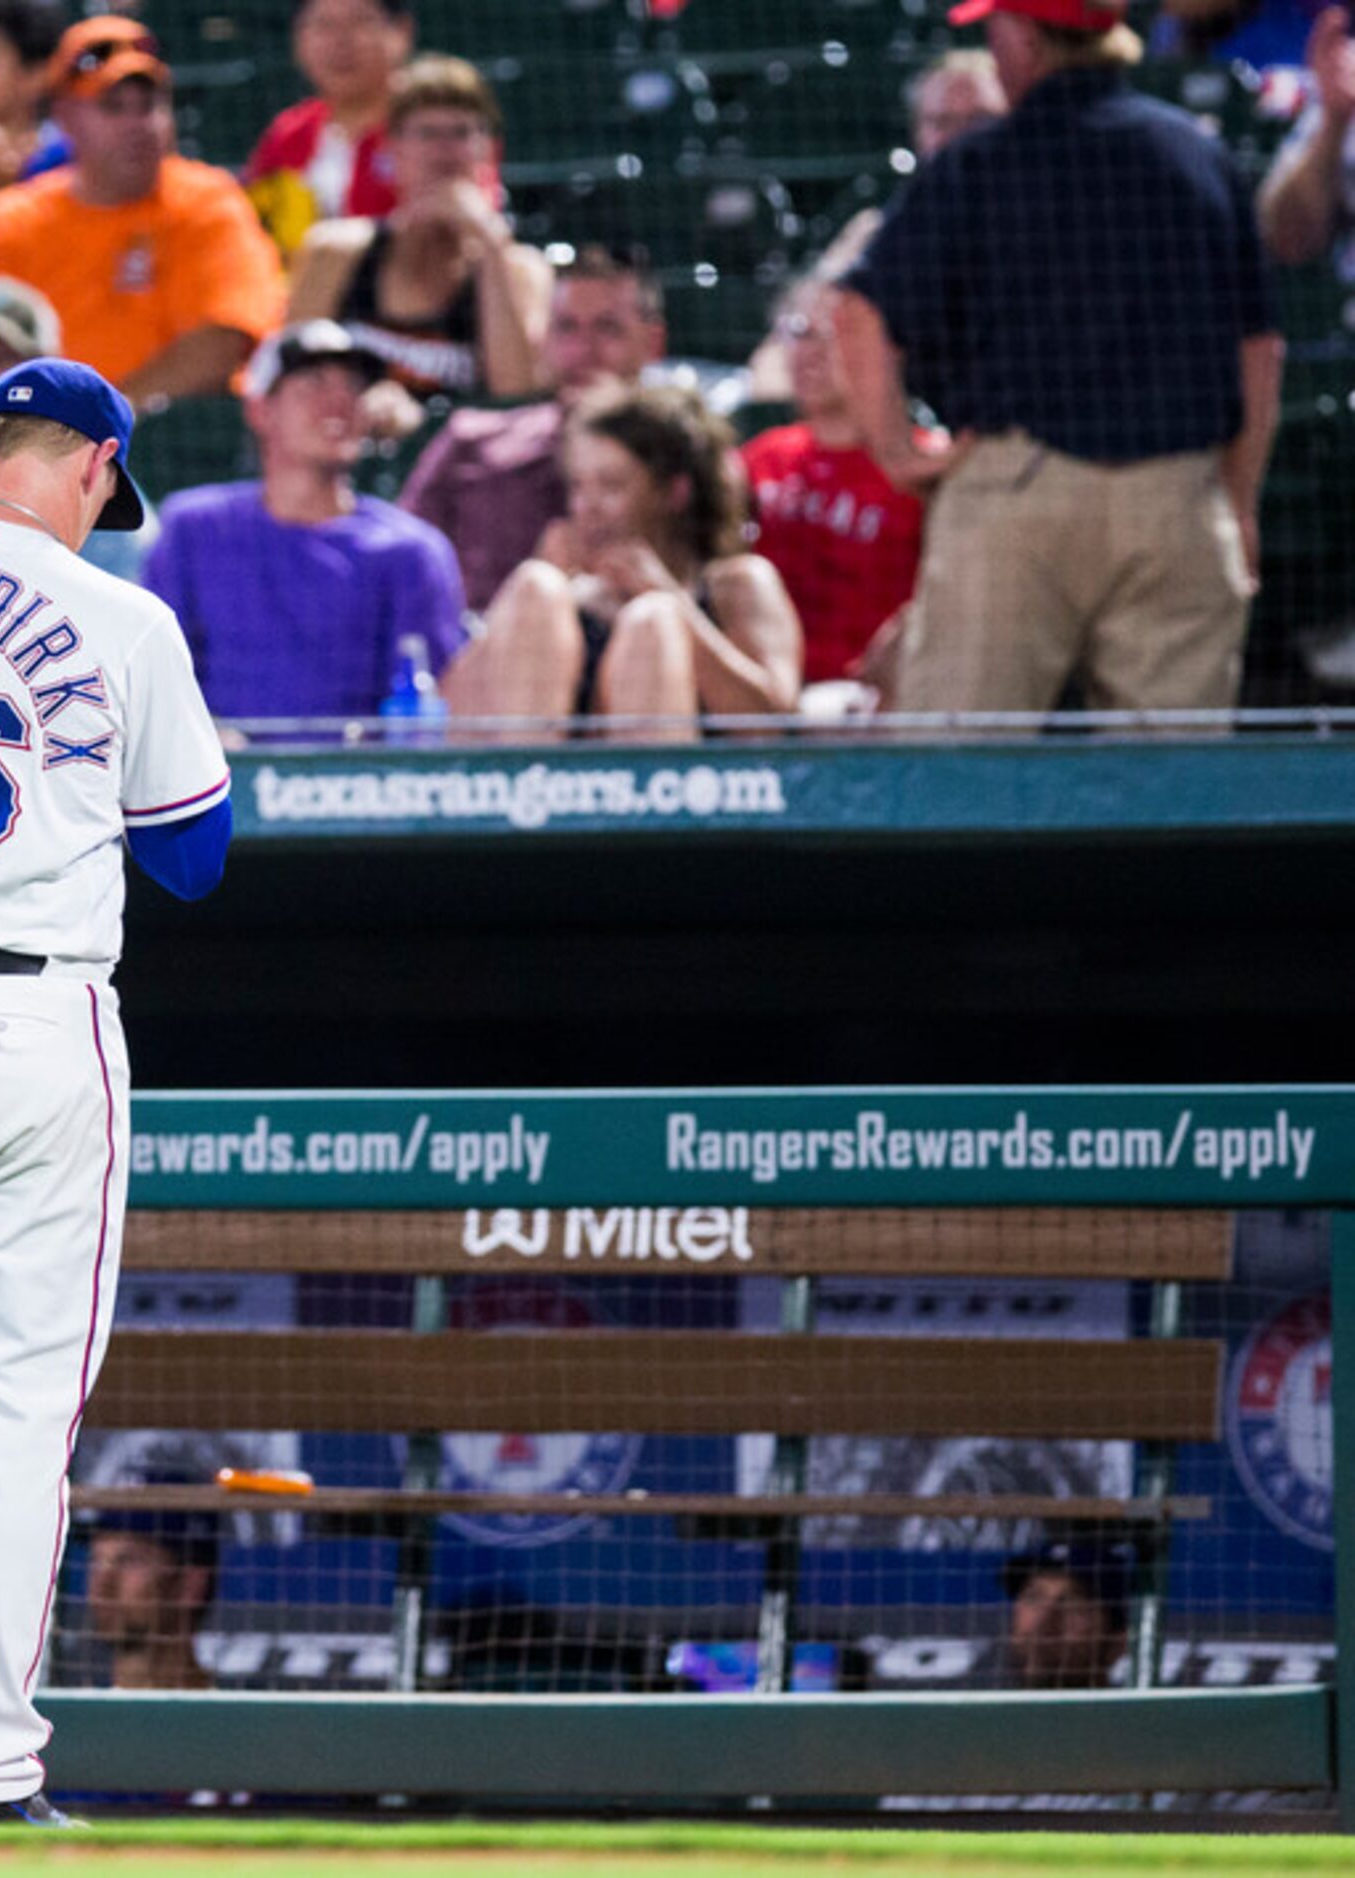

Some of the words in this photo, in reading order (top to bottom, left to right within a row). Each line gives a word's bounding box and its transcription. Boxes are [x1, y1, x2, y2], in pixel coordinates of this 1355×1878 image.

[253, 763, 787, 830] texasrangers.com
[666, 1109, 1316, 1182] RangersRewards.com/apply
[563, 1206, 754, 1262] Mitel
